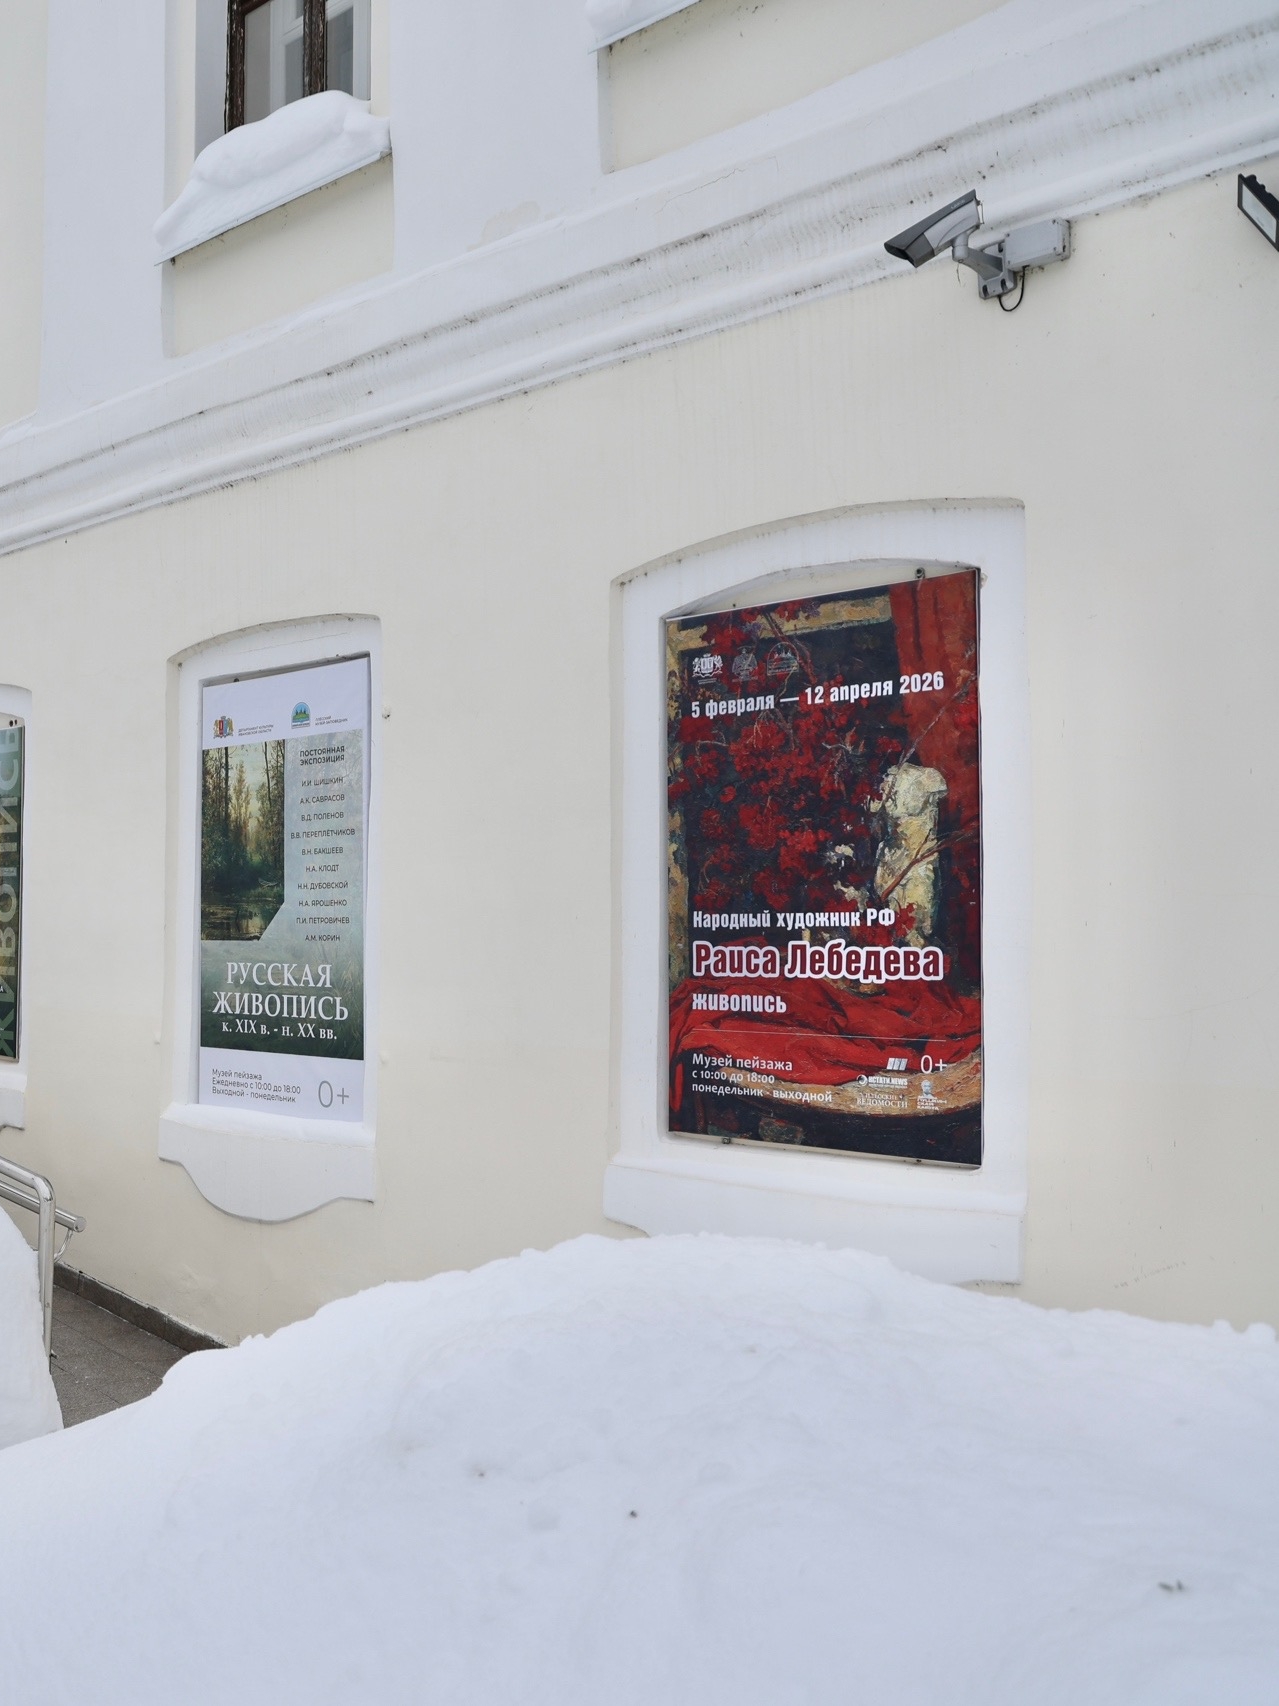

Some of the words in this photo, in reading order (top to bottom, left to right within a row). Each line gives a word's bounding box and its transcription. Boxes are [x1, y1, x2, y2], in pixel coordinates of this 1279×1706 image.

[691, 702, 701, 719] 5
[705, 694, 775, 720] февраля
[805, 686, 824, 705] 12
[830, 680, 893, 702] апреля
[899, 670, 944, 694] 2026
[300, 745, 345, 757] ПОСТОЯННАЯ
[300, 755, 345, 766] ЭКСПОЗИЦИЯ
[314, 777, 344, 786] ШИШКИН
[312, 794, 345, 803] САВРАСОВ
[314, 812, 344, 820] ПОЛЕНОВ
[319, 864, 339, 872] КЛОДТ
[310, 880, 349, 890] ДУБОВСКОЙ
[309, 916, 350, 924] ПЕТРОВИЧЕВ
[693, 910, 771, 931] Народный
[776, 910, 861, 930] художник
[866, 908, 895, 927] РФ
[693, 941, 780, 977] Раиса
[784, 939, 943, 984] Лебедева
[226, 961, 332, 988] РУССКАЯ
[212, 991, 349, 1021] ЖИВОПИСЬ
[692, 993, 787, 1013] живопись
[222, 1021, 232, 1032] к.
[235, 1018, 257, 1034] XIX
[260, 1024, 270, 1035] в.
[282, 1025, 294, 1037] н.
[297, 1023, 316, 1039] XX
[319, 1028, 337, 1040] вв.
[692, 1053, 732, 1068] Музей
[736, 1056, 793, 1071] пейзажа
[920, 1054, 948, 1074] 0+
[212, 1069, 233, 1078] Музей
[234, 1071, 262, 1081] пейзажа
[692, 1070, 697, 1078] с
[700, 1070, 727, 1081] 10:00
[729, 1073, 743, 1084] до
[746, 1072, 775, 1084] 18:00
[212, 1077, 248, 1089] Ежедневно
[255, 1081, 272, 1091] 10:00
[273, 1085, 281, 1093] до
[283, 1084, 301, 1094] 18:00
[318, 1080, 350, 1108] 0+
[692, 1083, 764, 1097] понедельник
[773, 1090, 832, 1103] выходной
[212, 1086, 245, 1097] Выходной
[250, 1092, 296, 1103] понедельник
